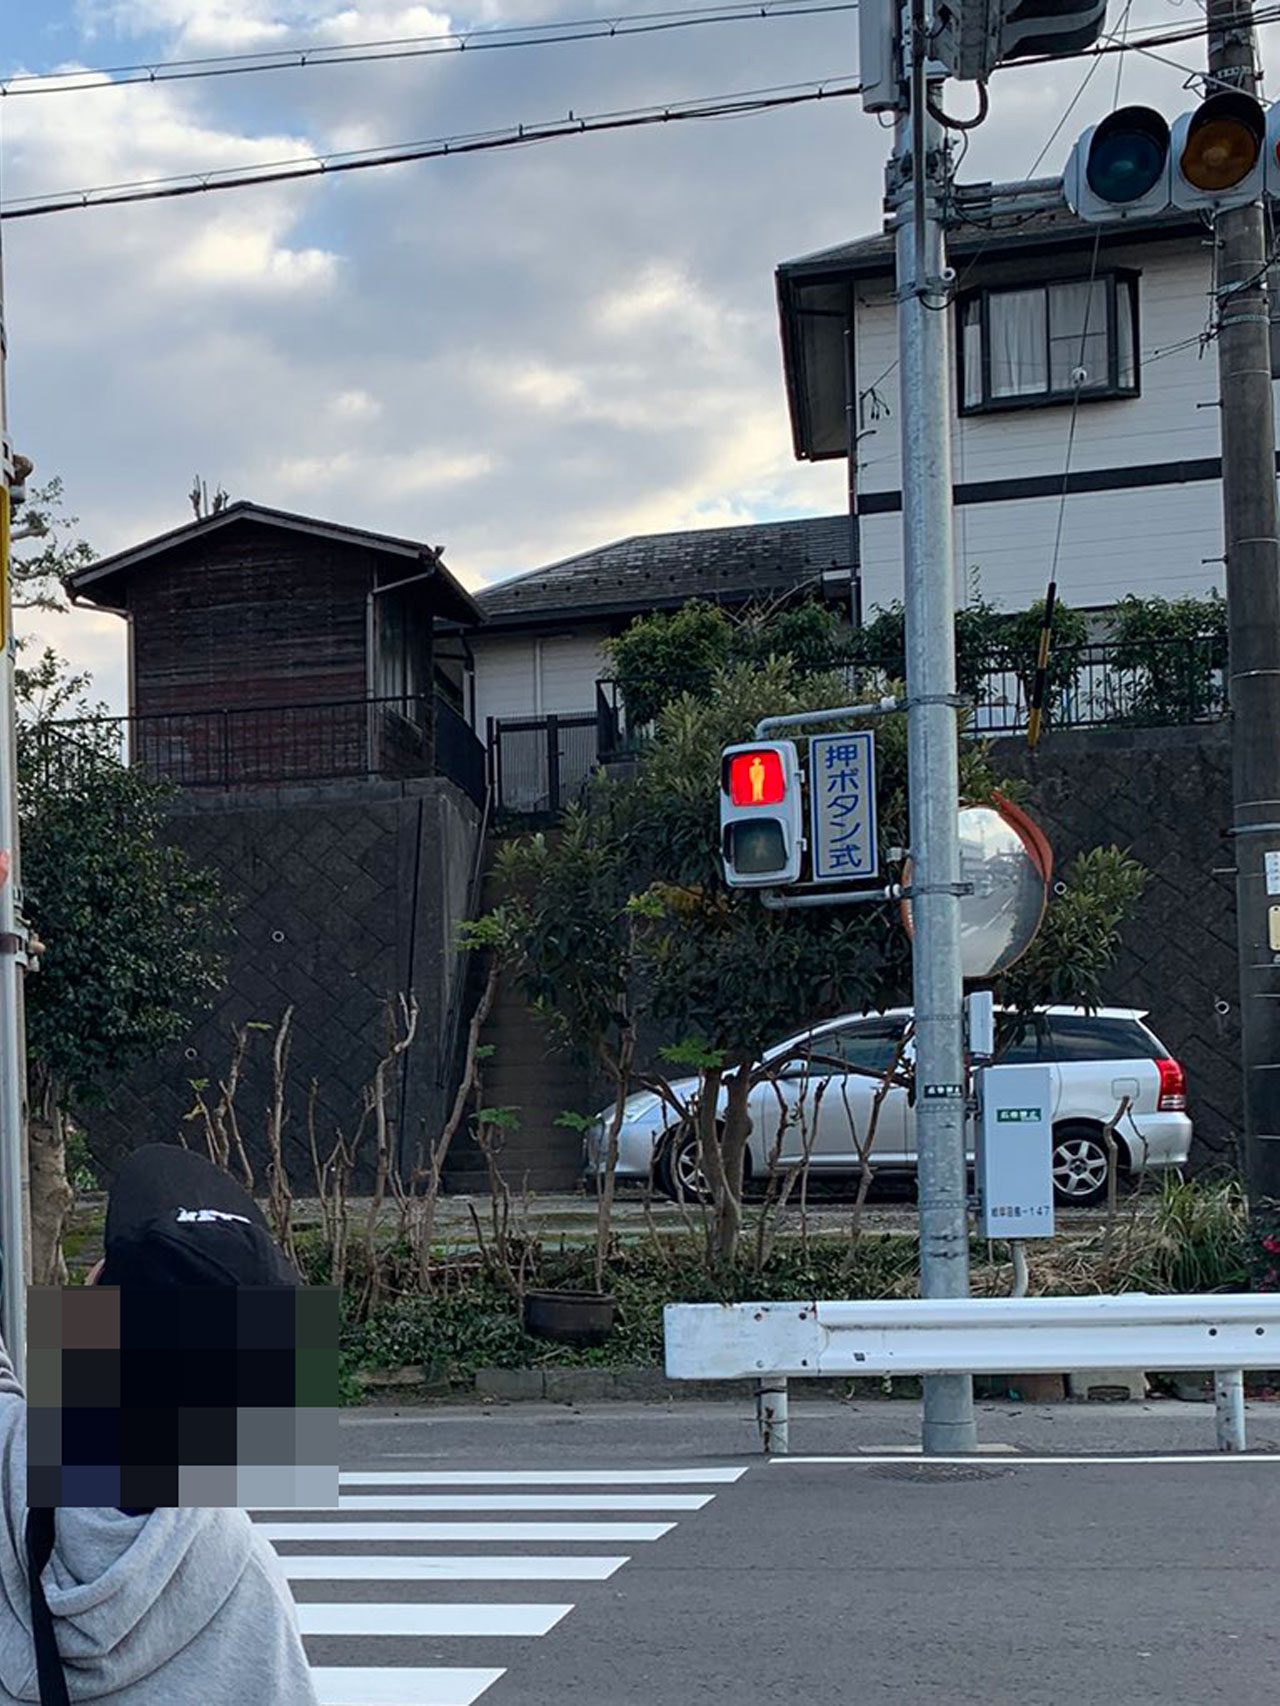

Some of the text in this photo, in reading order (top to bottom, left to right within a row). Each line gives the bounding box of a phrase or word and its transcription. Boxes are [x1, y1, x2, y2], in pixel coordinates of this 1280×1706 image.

[825, 744, 862, 869] 押ボタン式
